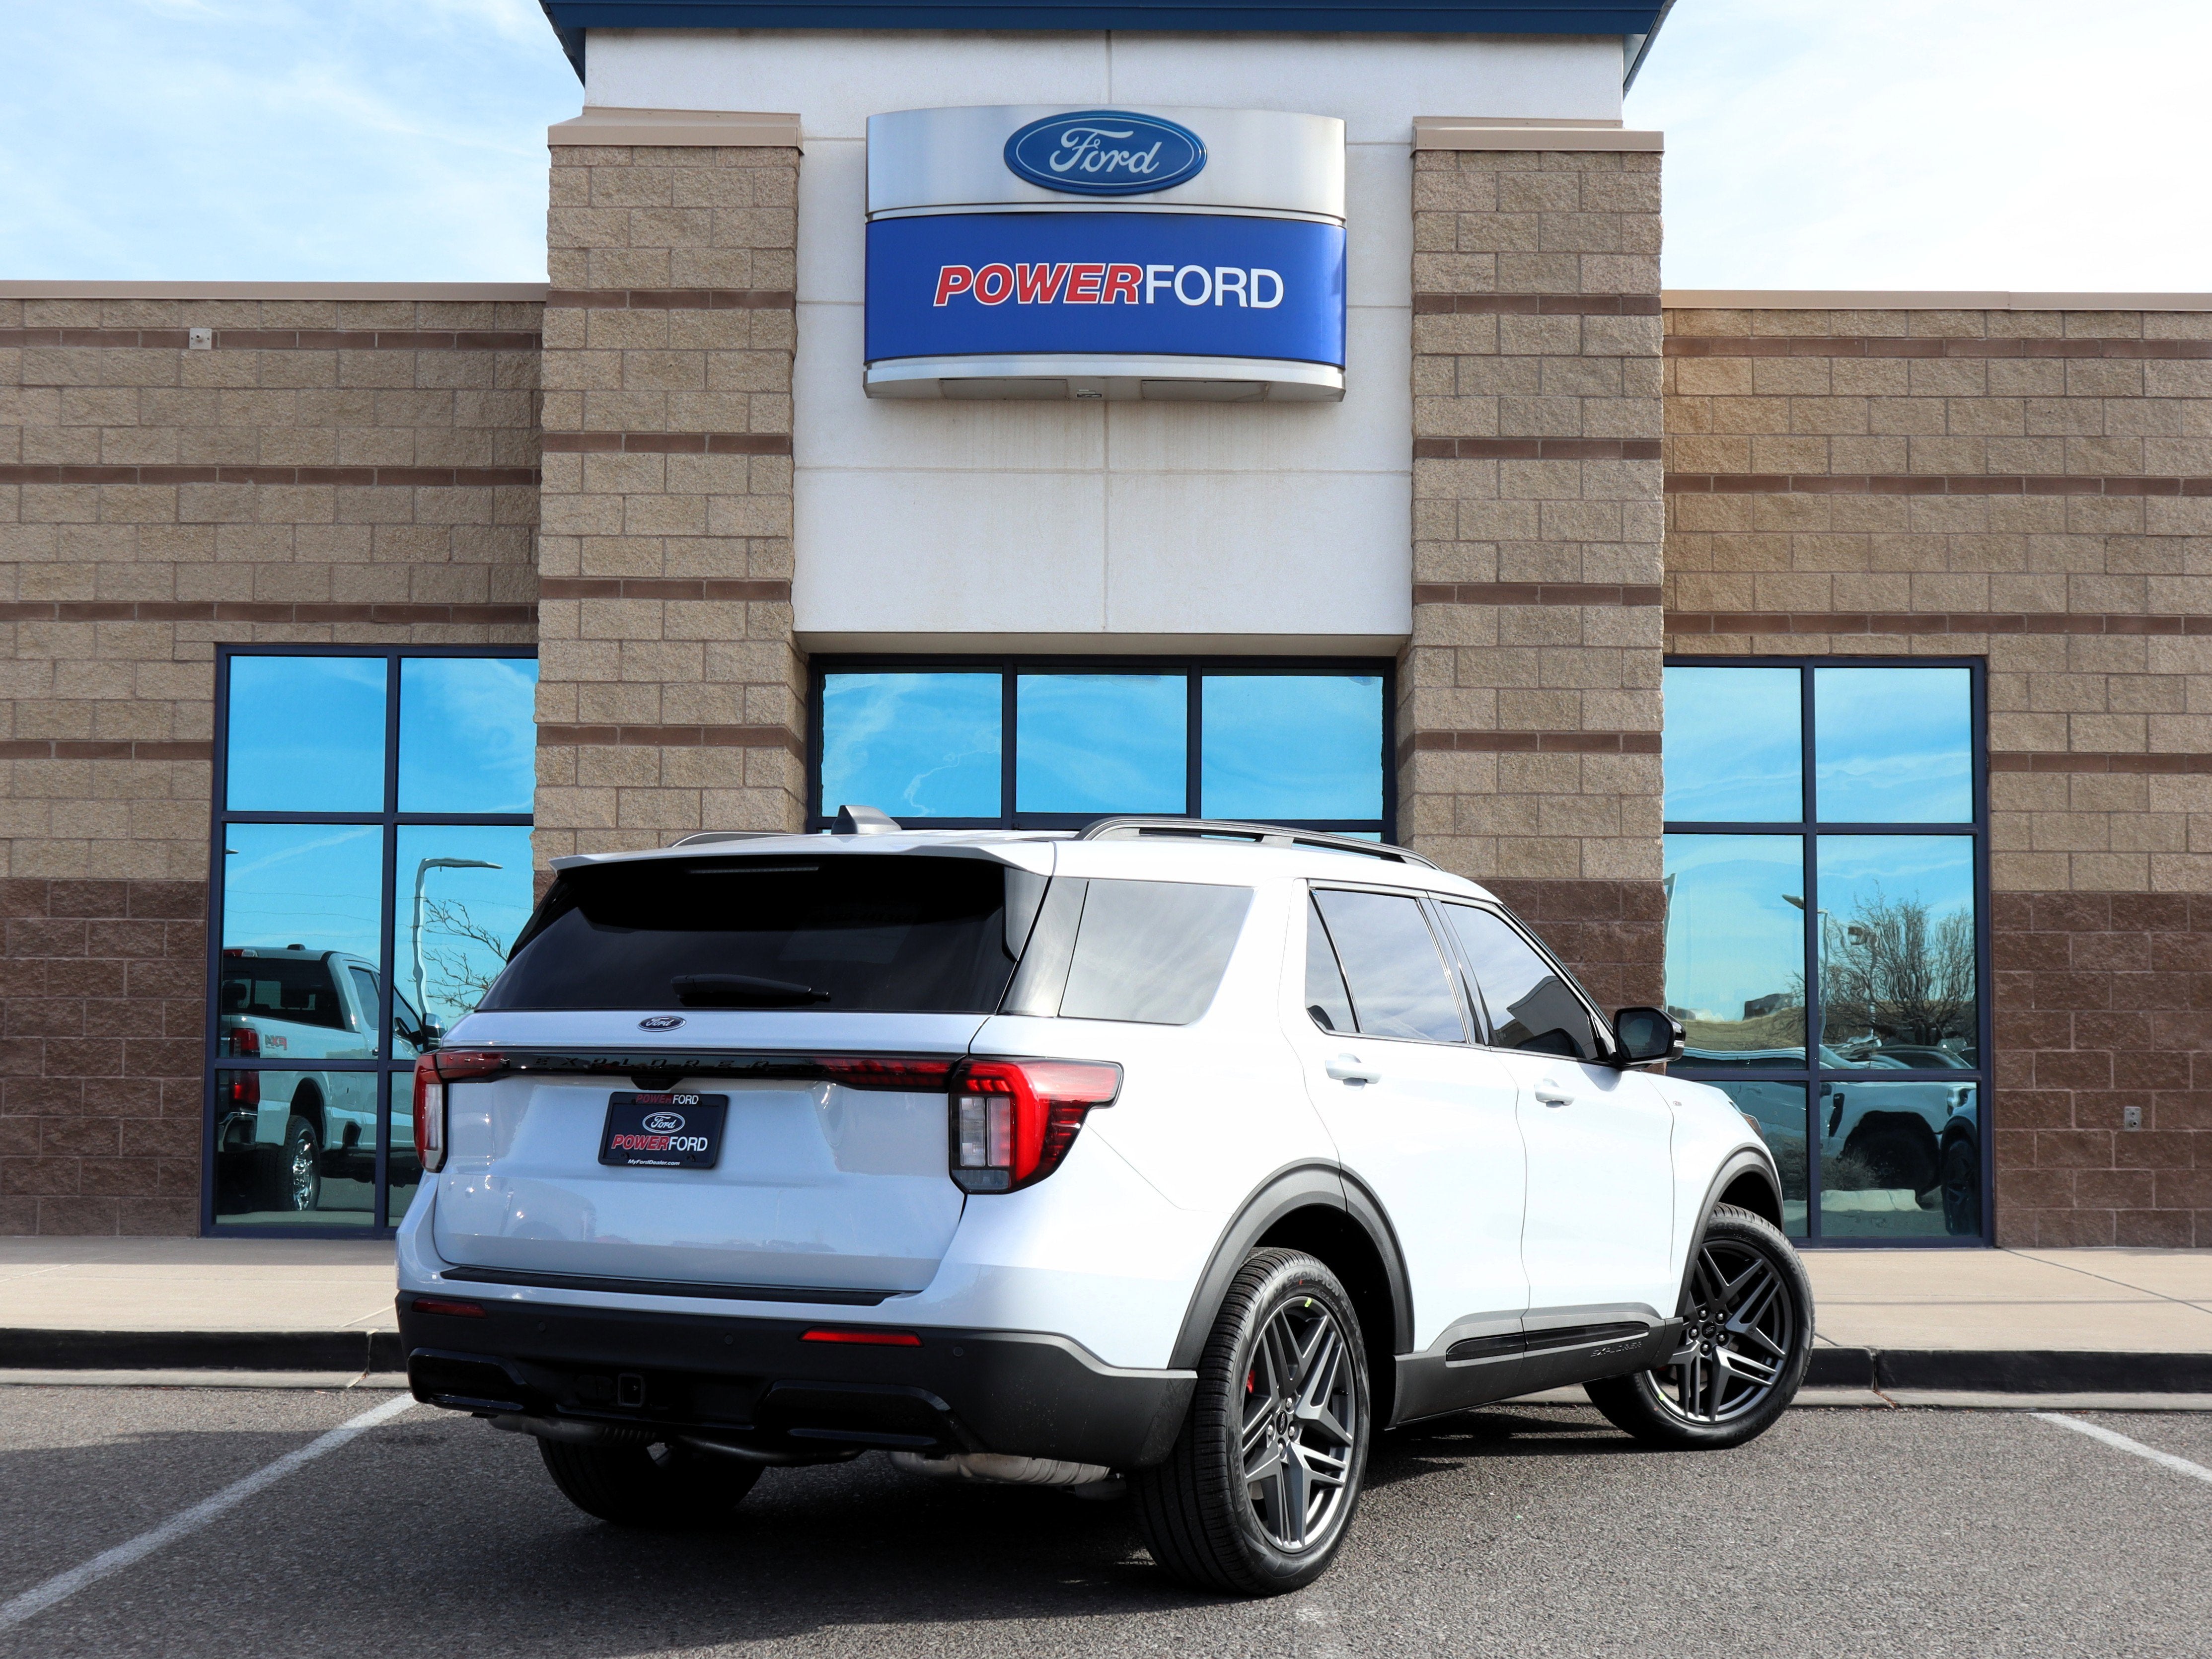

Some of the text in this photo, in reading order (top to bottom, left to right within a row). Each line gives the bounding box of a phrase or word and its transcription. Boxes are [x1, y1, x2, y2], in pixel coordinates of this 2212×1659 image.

[1049, 127, 1162, 175] Ford
[933, 262, 1284, 308] POWERFORD
[646, 1017, 674, 1026] Ford
[534, 1057, 770, 1069] EXPLORER
[651, 1115, 676, 1129] Ford
[611, 1134, 708, 1152] POWERFORD
[1590, 1342, 1642, 1358] EXPLORER
